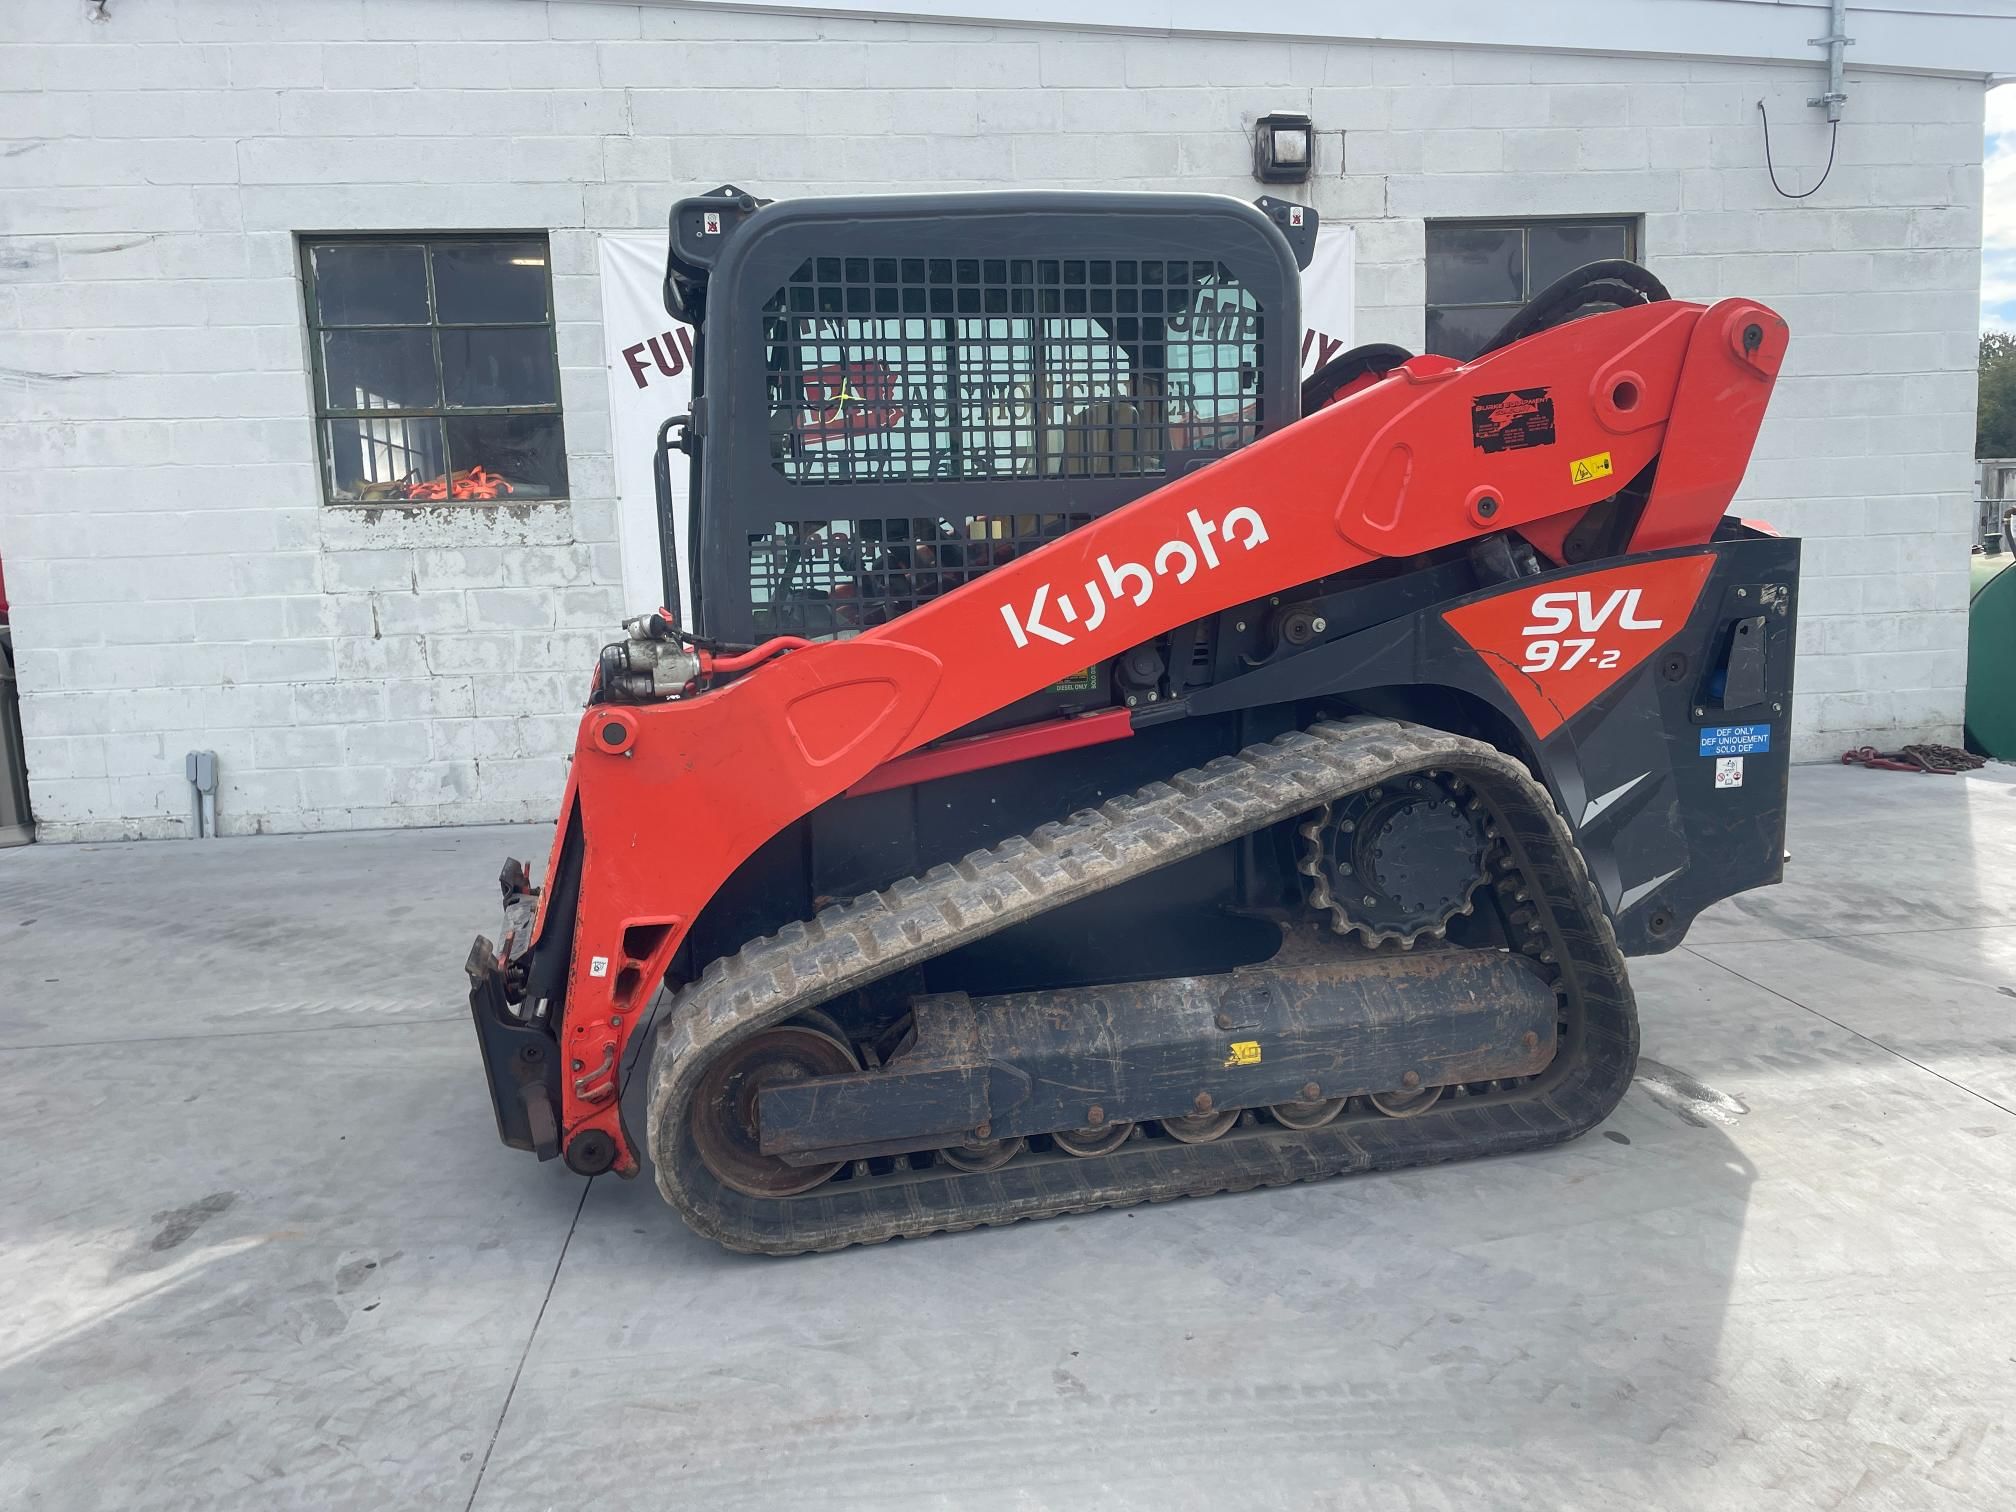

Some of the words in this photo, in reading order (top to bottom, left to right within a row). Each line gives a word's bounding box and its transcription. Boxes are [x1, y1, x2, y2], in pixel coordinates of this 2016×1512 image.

[1000, 506, 1270, 649] Kubota
[1521, 589, 1663, 636] SVL
[1521, 638, 1621, 673] 97-2
[1701, 737, 1717, 746] DEF
[1718, 735, 1768, 745] UNIQUEMENT
[1716, 728, 1732, 737] DEF
[1734, 727, 1754, 736] ONLY
[1716, 745, 1736, 754] SOLO
[1738, 744, 1754, 752] DEF
